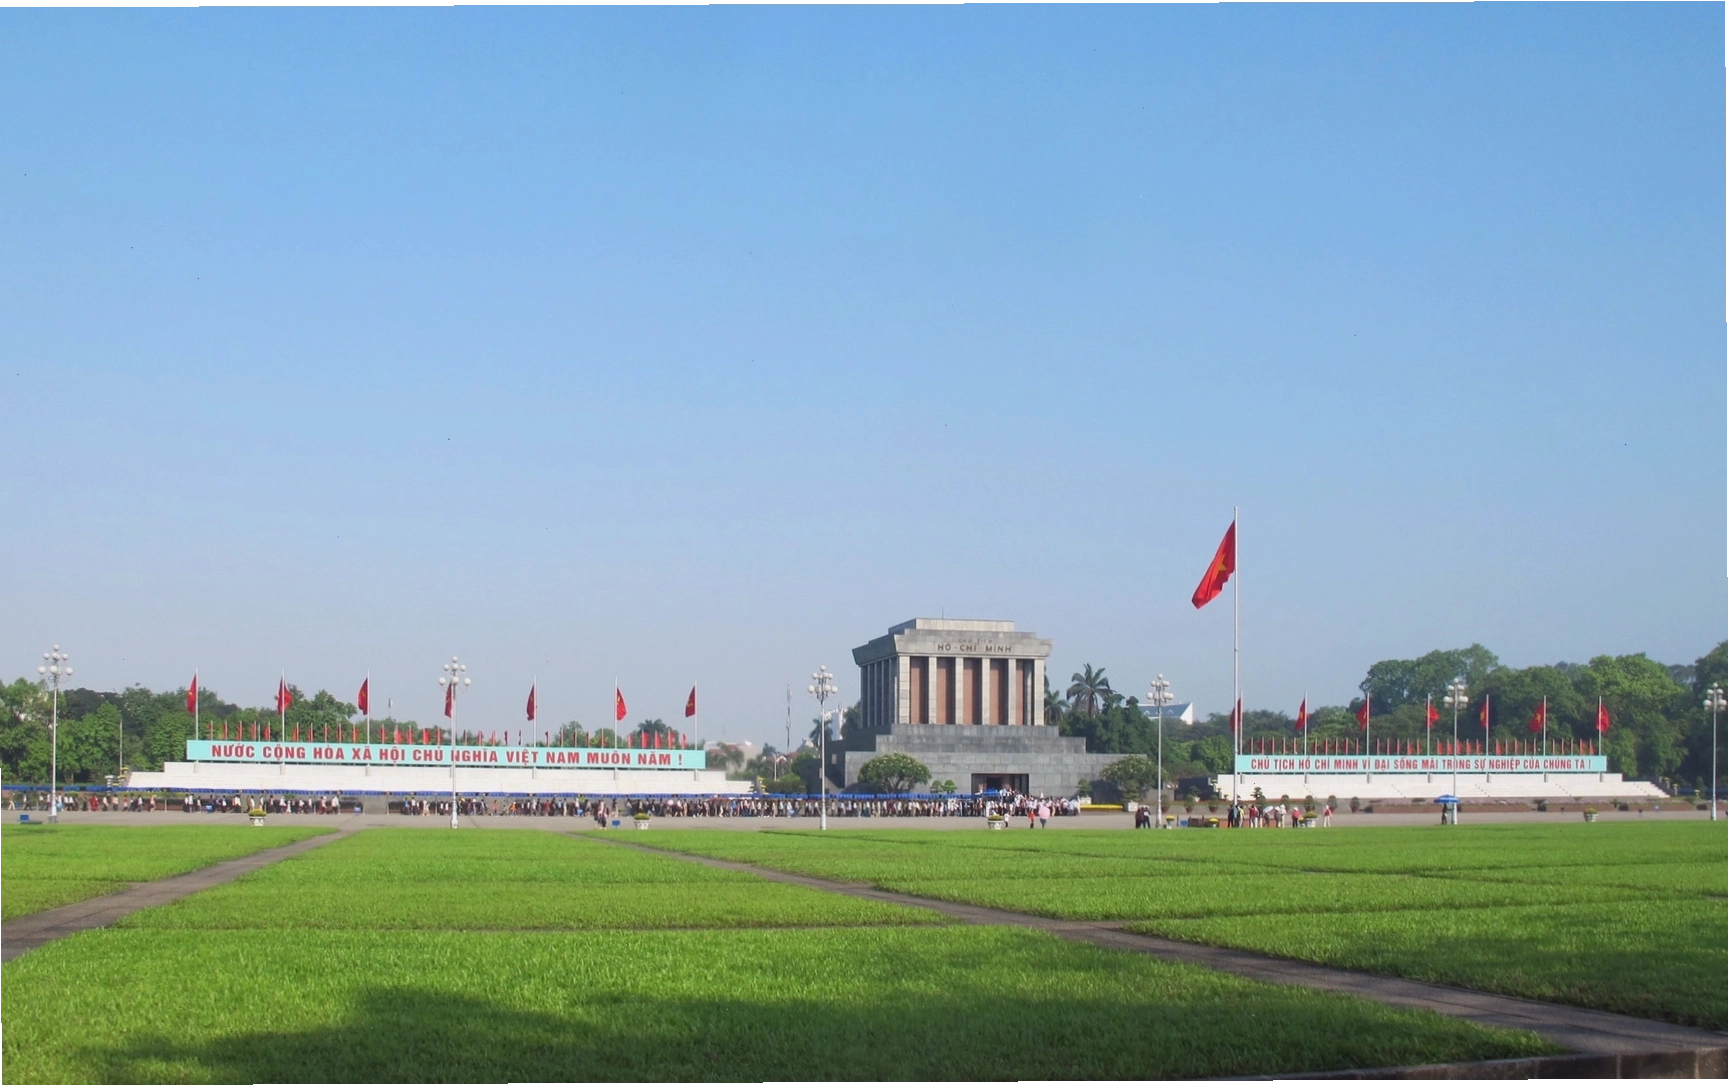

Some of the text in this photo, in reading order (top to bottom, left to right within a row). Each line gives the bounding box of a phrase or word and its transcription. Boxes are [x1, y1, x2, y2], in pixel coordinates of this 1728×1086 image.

[212, 743, 255, 758] NƯỚC
[262, 744, 306, 760] CỘNG
[314, 745, 344, 760] HÒA
[352, 746, 372, 760] XÃ
[379, 746, 405, 762] HỘI
[412, 746, 444, 762] CHỦ
[451, 748, 498, 762] NGHĨA
[506, 749, 538, 766] VIỆT
[546, 752, 580, 764] NAM
[587, 750, 630, 764] MUÔN
[638, 751, 671, 766] NĂM
[1251, 756, 1270, 770] CHỦ
[1274, 759, 1294, 772] TỊCH
[1299, 756, 1310, 770] HỒ
[1334, 758, 1358, 770] MINH
[1375, 758, 1390, 772] ĐẠI
[1394, 756, 1418, 770] SỐNG
[1442, 758, 1470, 770] TRONG
[1474, 758, 1486, 772] SỰ
[1488, 757, 1520, 772] NGHIỆP
[1524, 756, 1540, 770] CỦA
[1544, 757, 1572, 770] CHÚNG
[1575, 759, 1584, 769] TA
